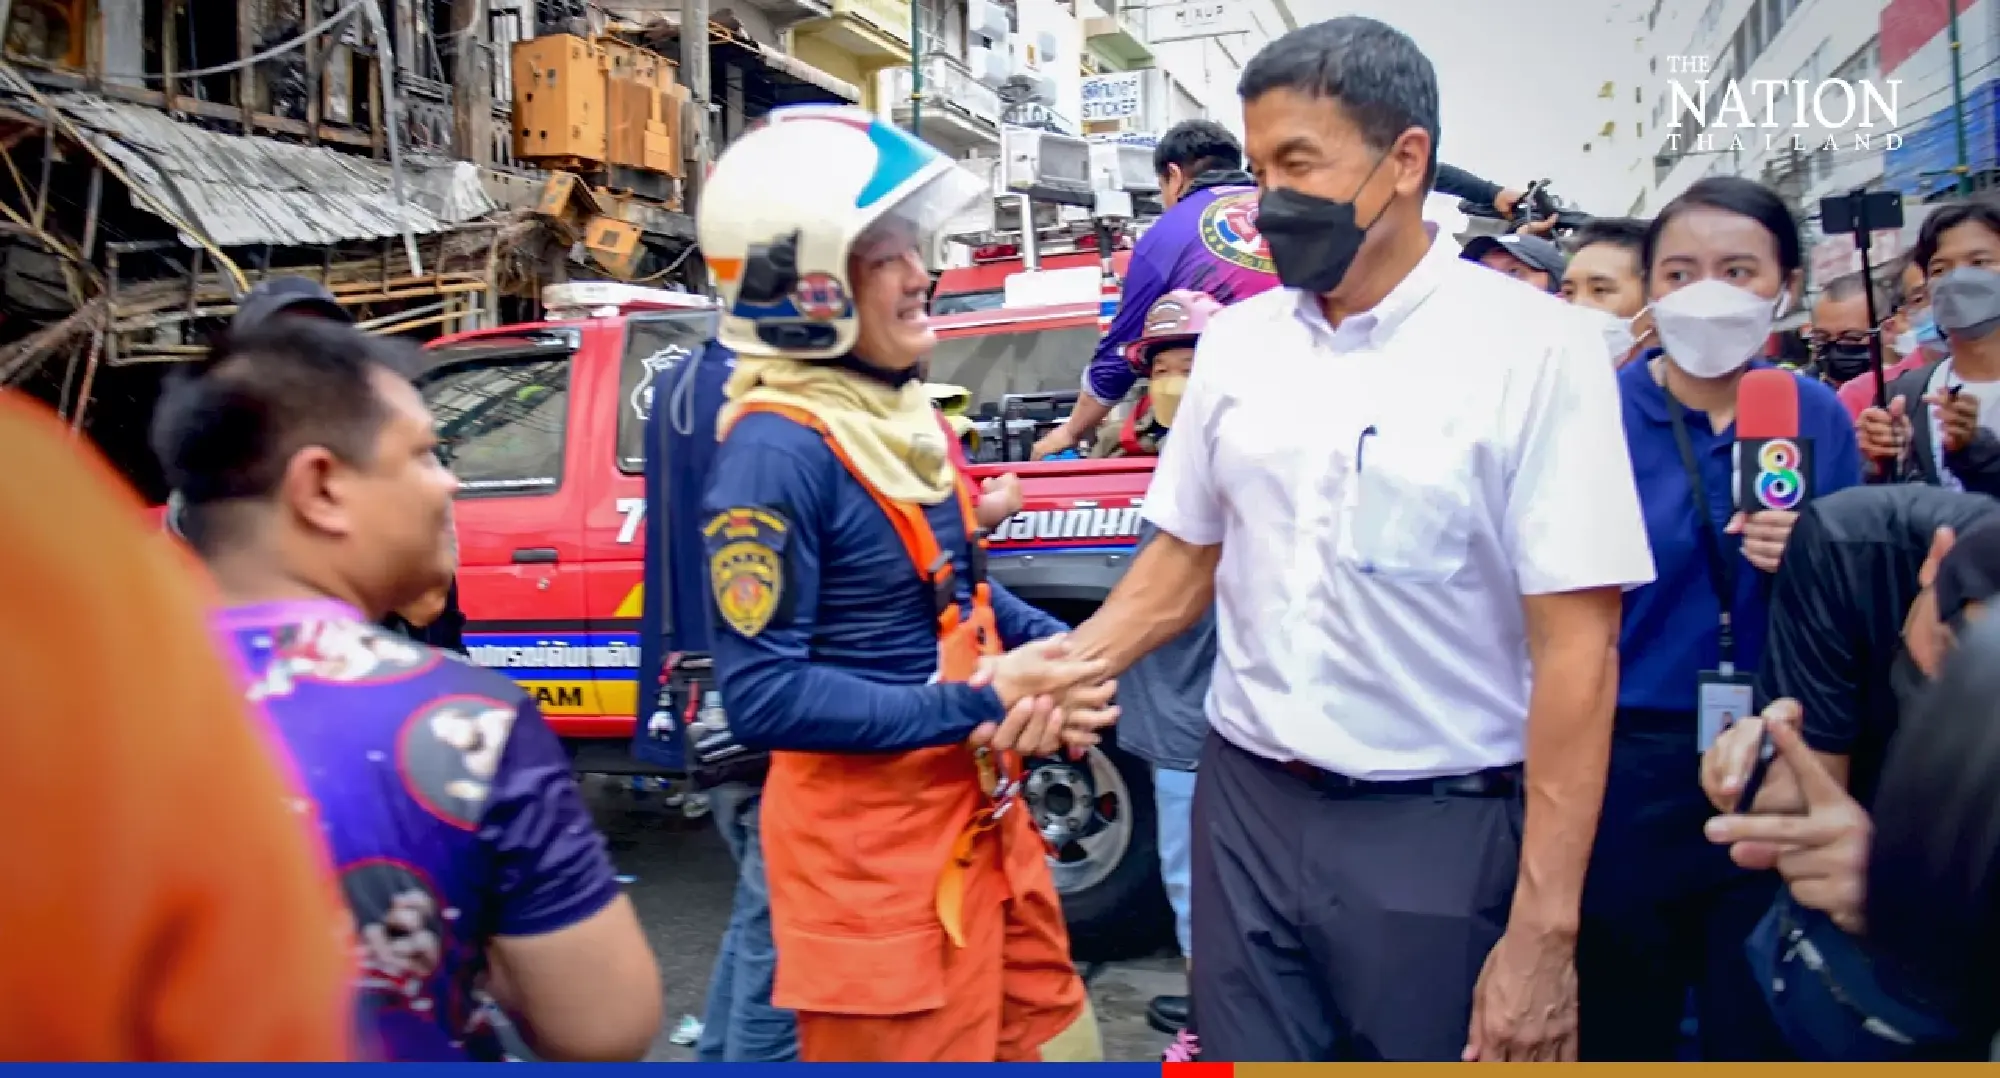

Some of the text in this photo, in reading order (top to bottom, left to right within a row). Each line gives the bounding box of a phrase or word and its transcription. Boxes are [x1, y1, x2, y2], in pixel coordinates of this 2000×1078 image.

[1082, 98, 1138, 118] STICKER
[1753, 438, 1806, 509] 8
[615, 498, 645, 543] 7
[522, 686, 583, 706] AM
